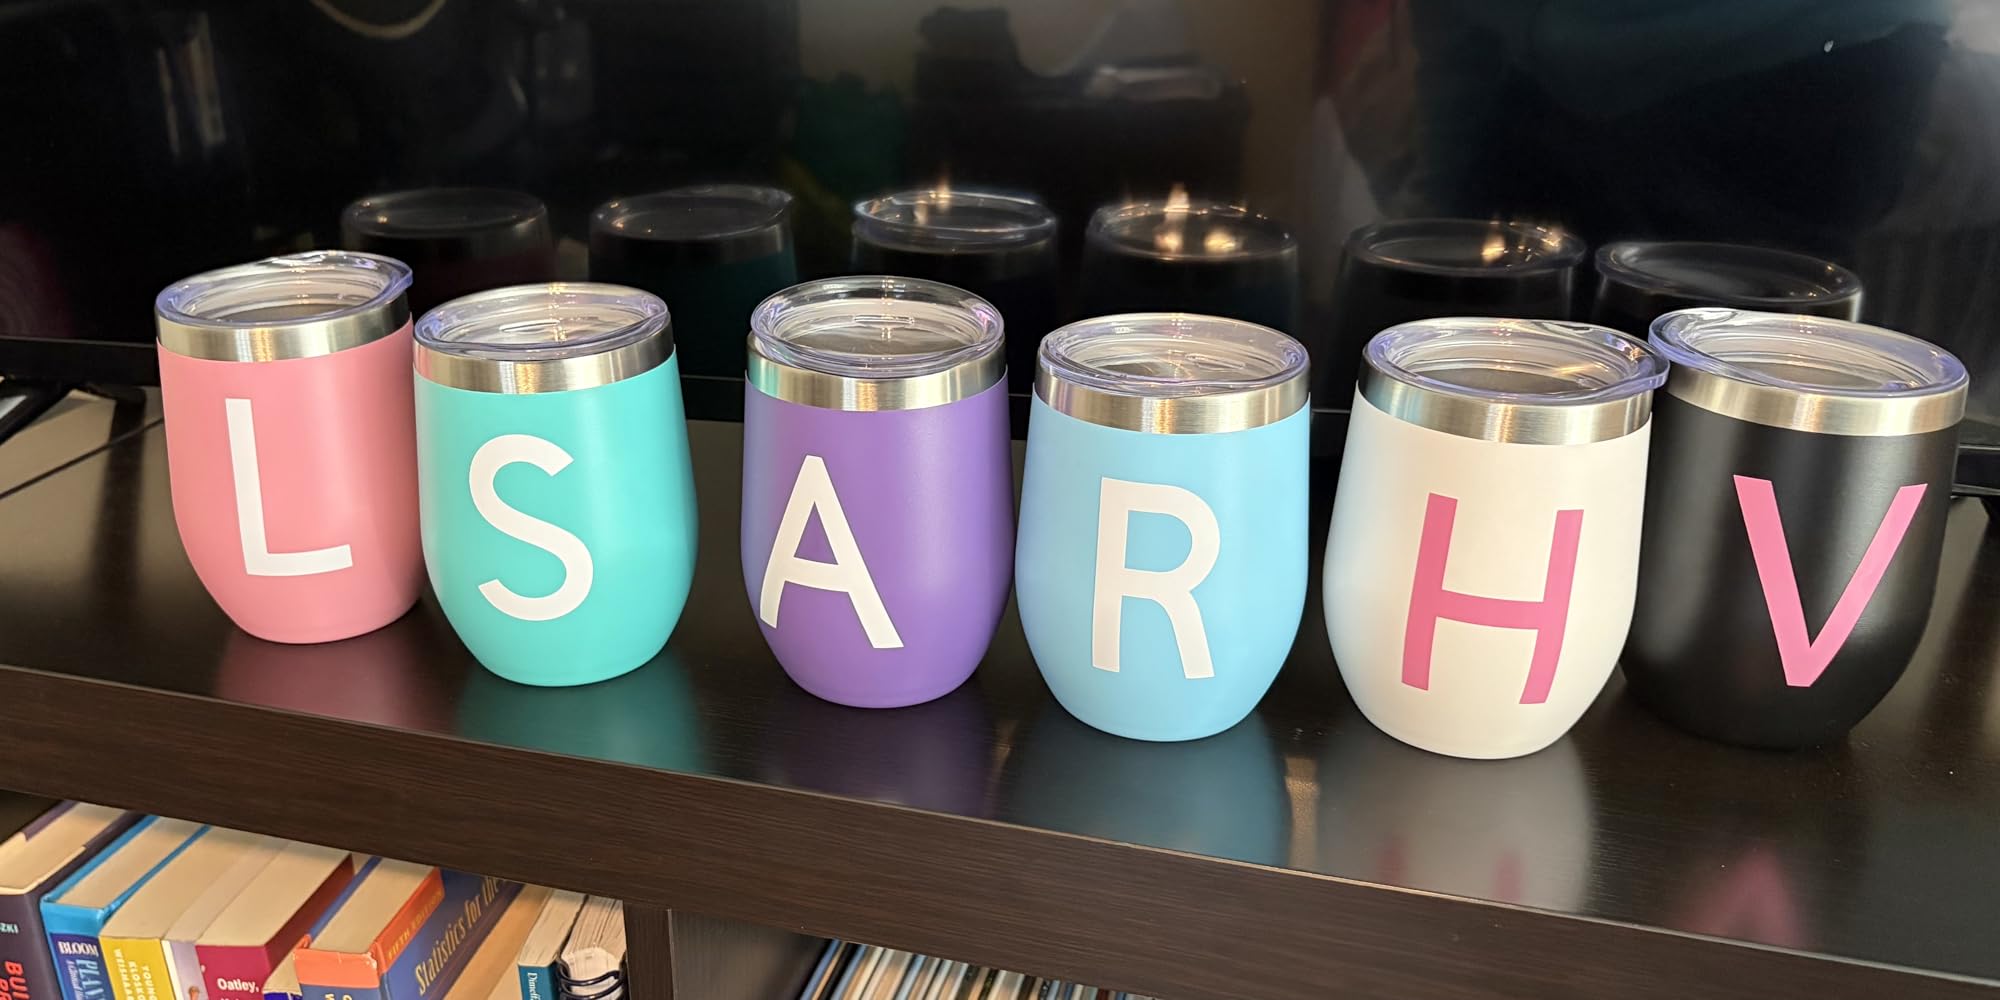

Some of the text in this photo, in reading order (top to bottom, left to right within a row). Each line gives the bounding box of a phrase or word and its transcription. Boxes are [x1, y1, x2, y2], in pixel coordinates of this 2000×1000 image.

[225, 399, 352, 577] L
[469, 435, 594, 621] S
[759, 455, 904, 649] A
[1091, 477, 1222, 680] R
[1734, 476, 1928, 688] V
[1401, 493, 1585, 705] H
[415, 917, 467, 996] Statistics
[464, 894, 482, 929] for
